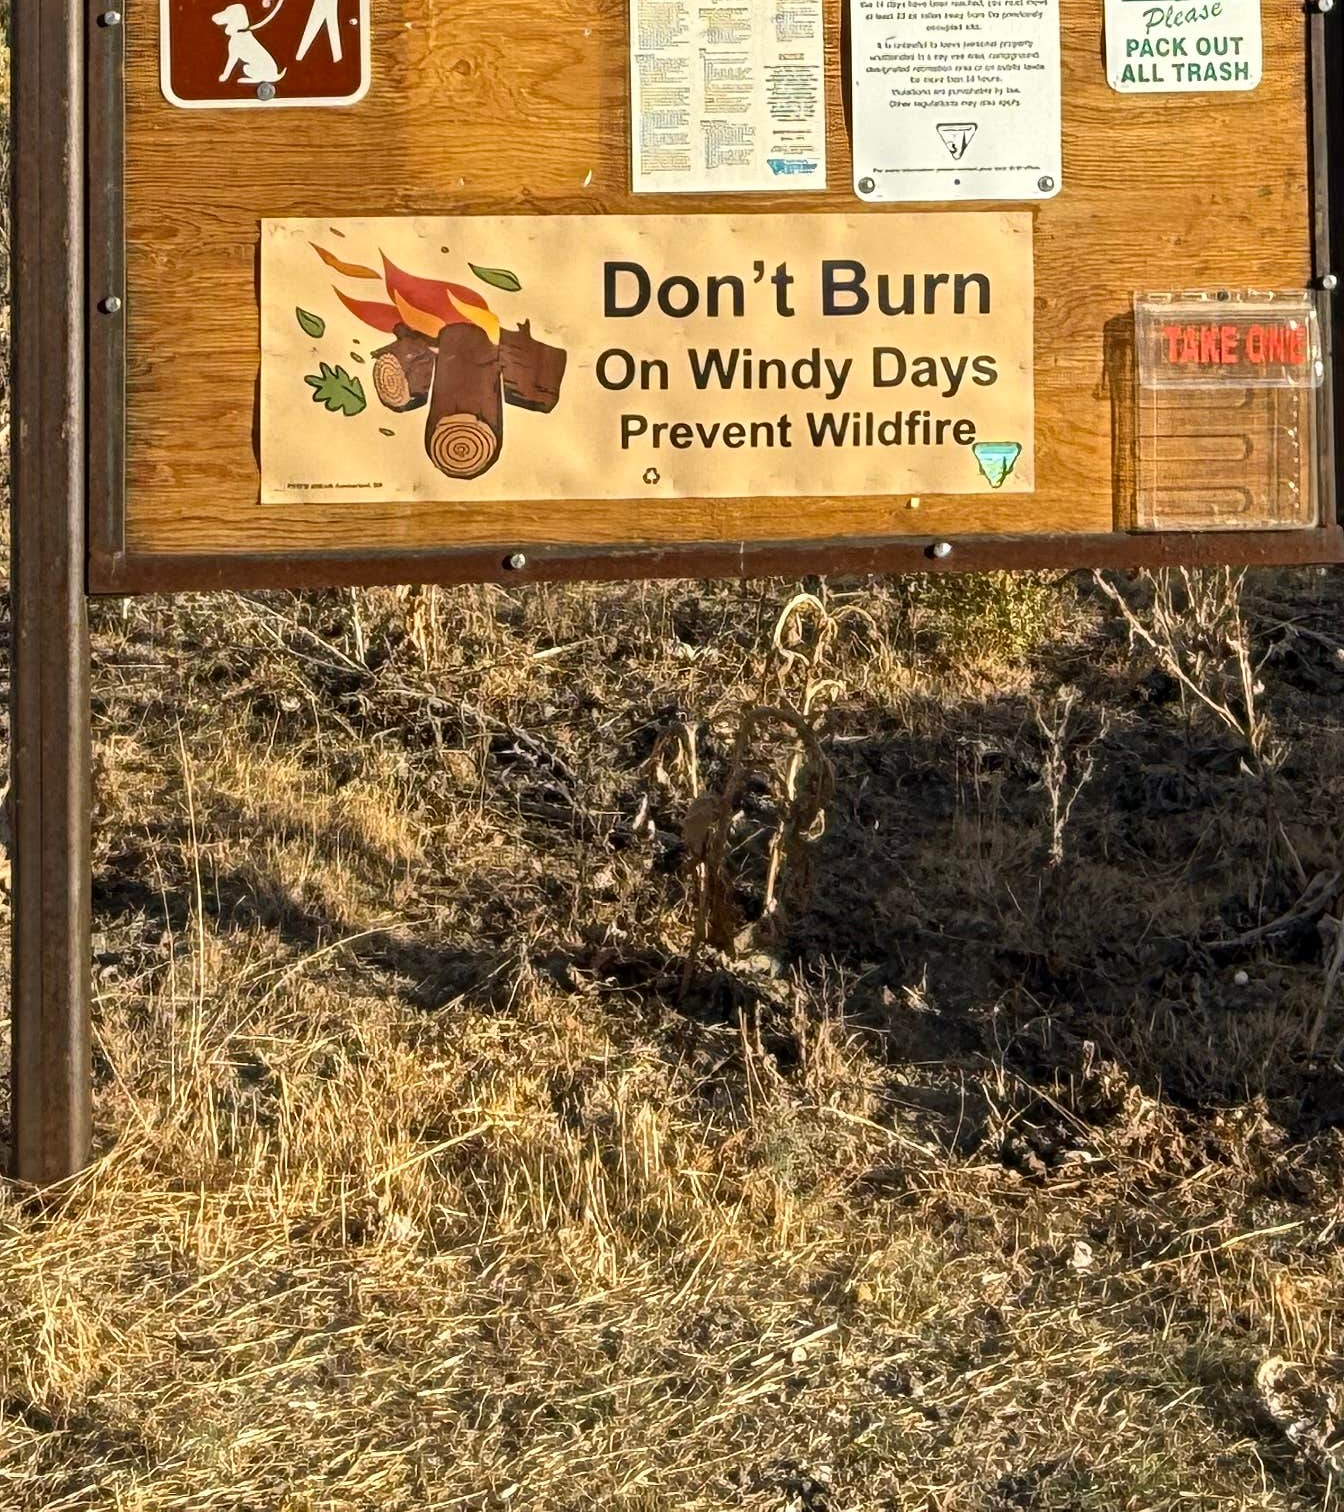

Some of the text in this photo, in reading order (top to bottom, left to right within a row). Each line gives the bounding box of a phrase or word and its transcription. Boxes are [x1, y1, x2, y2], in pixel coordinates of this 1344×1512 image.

[1143, 2, 1223, 35] Please
[1126, 36, 1243, 57] PACK OUT
[1121, 62, 1249, 83] ALL TRASH
[603, 259, 991, 318] Don't Burn
[1163, 324, 1306, 365] TAKE ONE
[596, 346, 998, 399] On Windy Days
[621, 411, 976, 449] Prevent Wildfire
